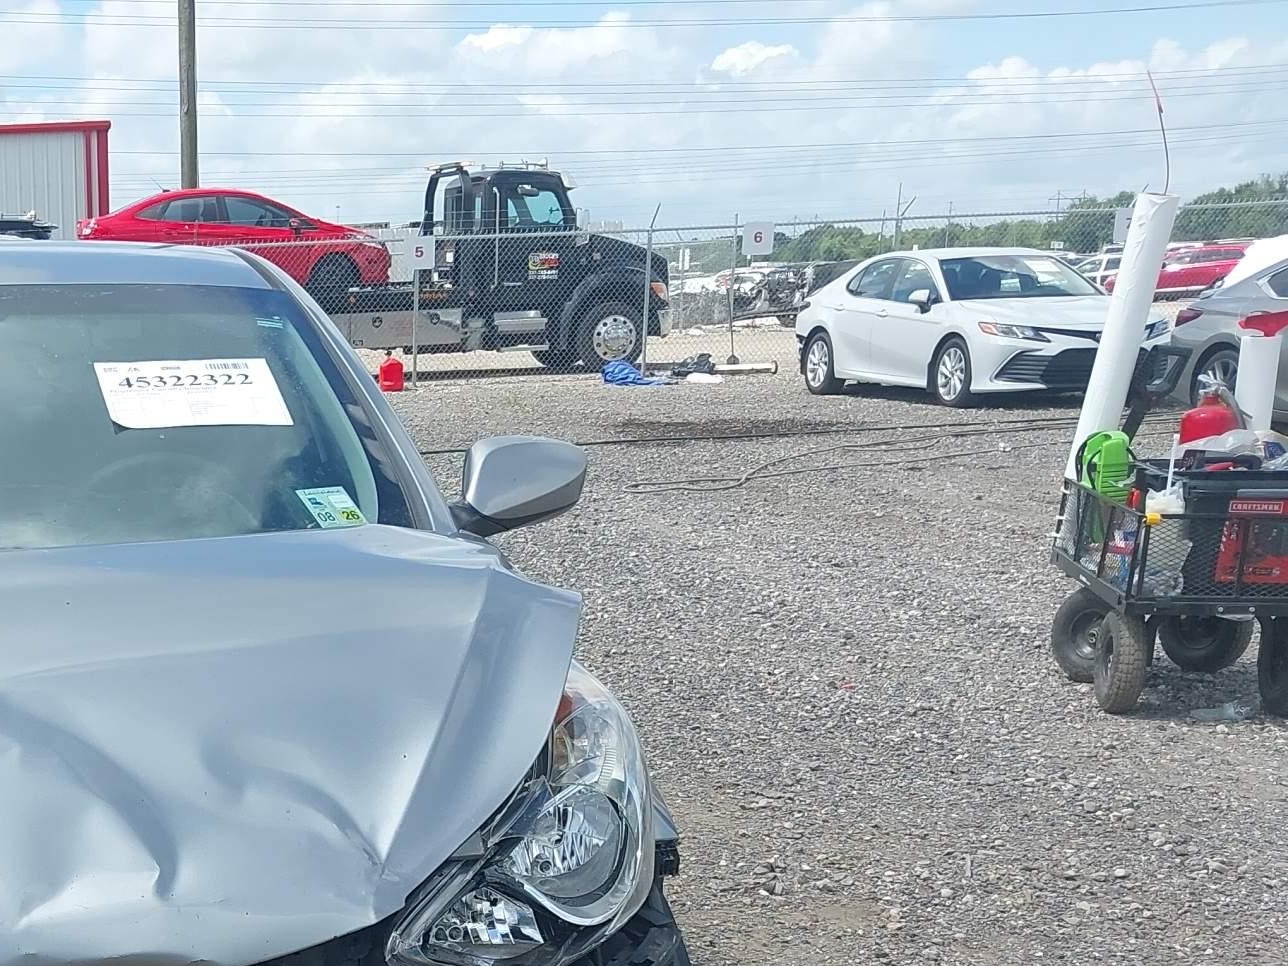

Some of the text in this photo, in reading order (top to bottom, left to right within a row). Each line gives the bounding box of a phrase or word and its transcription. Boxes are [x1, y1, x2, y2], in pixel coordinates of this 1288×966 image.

[753, 231, 763, 244] 6
[414, 246, 424, 258] 5
[118, 373, 253, 388] 45322322
[1231, 502, 1281, 511] CRAFTSMAN
[317, 510, 361, 522] 08 26
